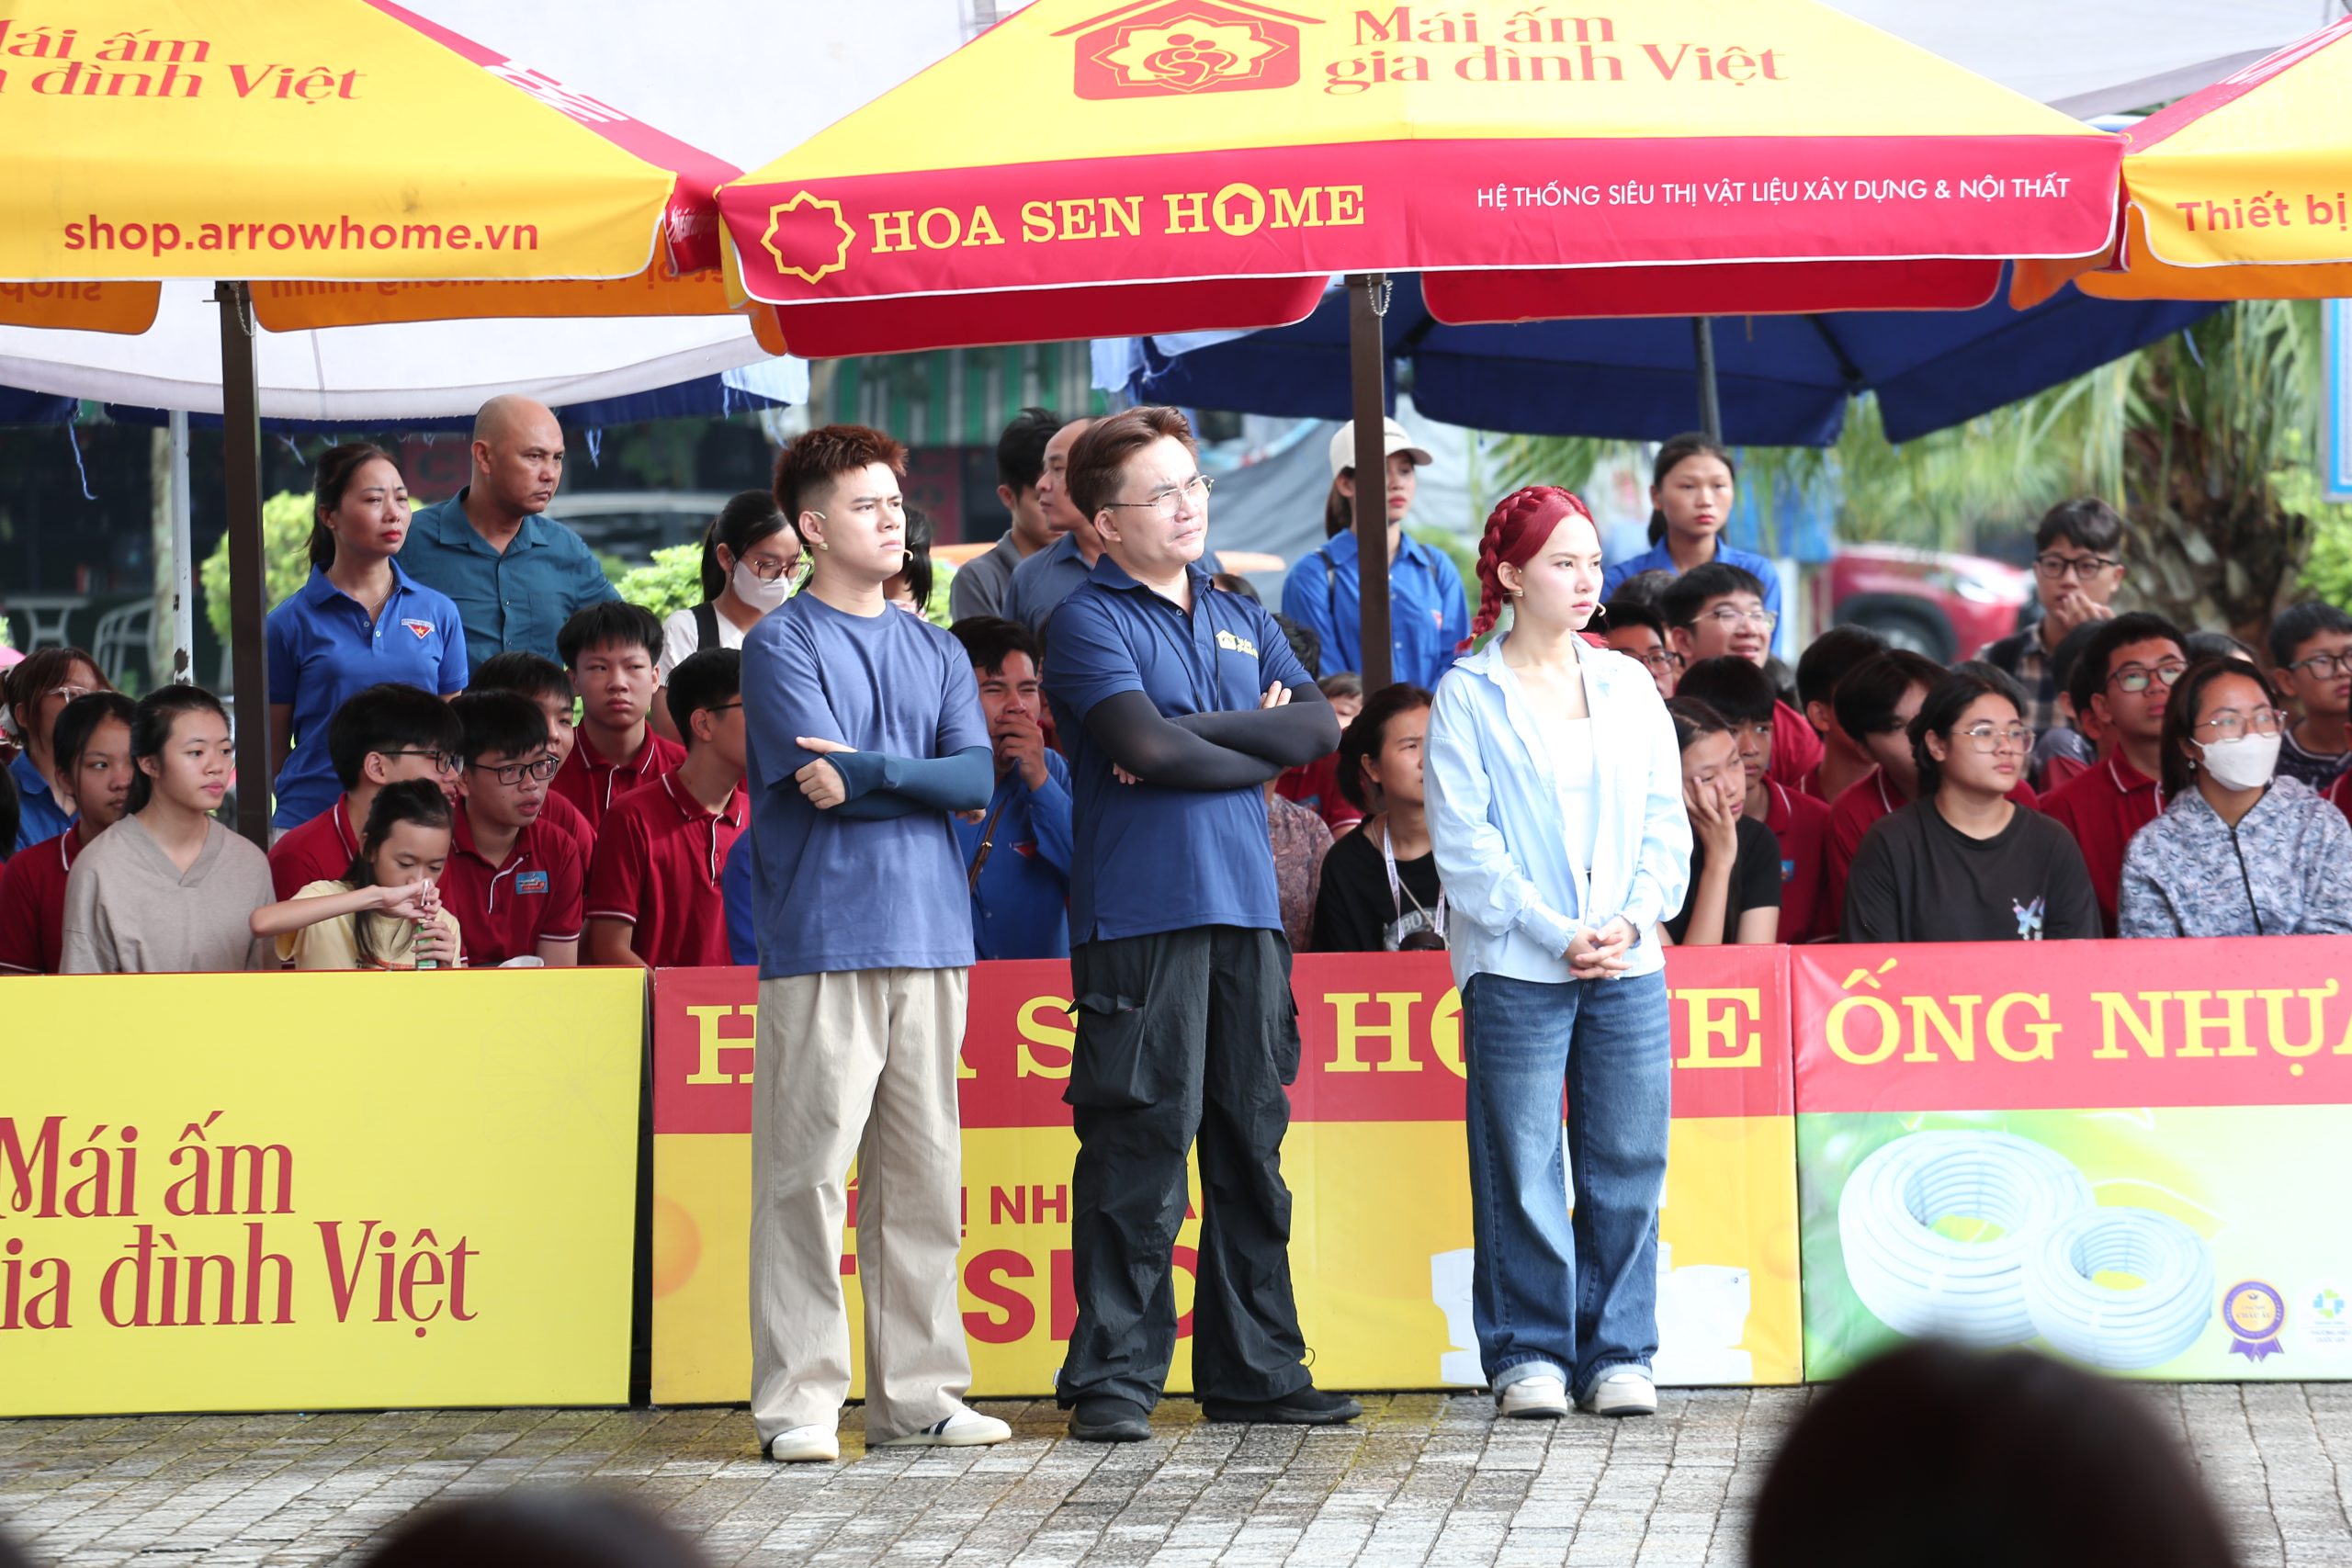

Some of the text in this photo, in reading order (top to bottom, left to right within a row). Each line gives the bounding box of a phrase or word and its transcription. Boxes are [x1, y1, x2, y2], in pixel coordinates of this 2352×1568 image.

[0, 19, 210, 63] ái ấm
[1354, 6, 1615, 46] Mái ấm
[31, 61, 367, 106] đình Việt
[1325, 43, 1789, 95] gia đình Việt
[1477, 172, 2071, 211] HỆ THỐNG SIÊU THỊ VẬT LIỆU XÂY DỰNG & NỘI THẤT
[2176, 189, 2346, 232] Thiết bị
[64, 214, 538, 257] shop.arrowhome.vn
[869, 183, 1365, 254] HOA SEN HOME
[1826, 958, 2352, 1077] ỐNG NHỰ
[164, 1110, 296, 1216] ấm
[0, 1220, 481, 1338] ia đình Việt
